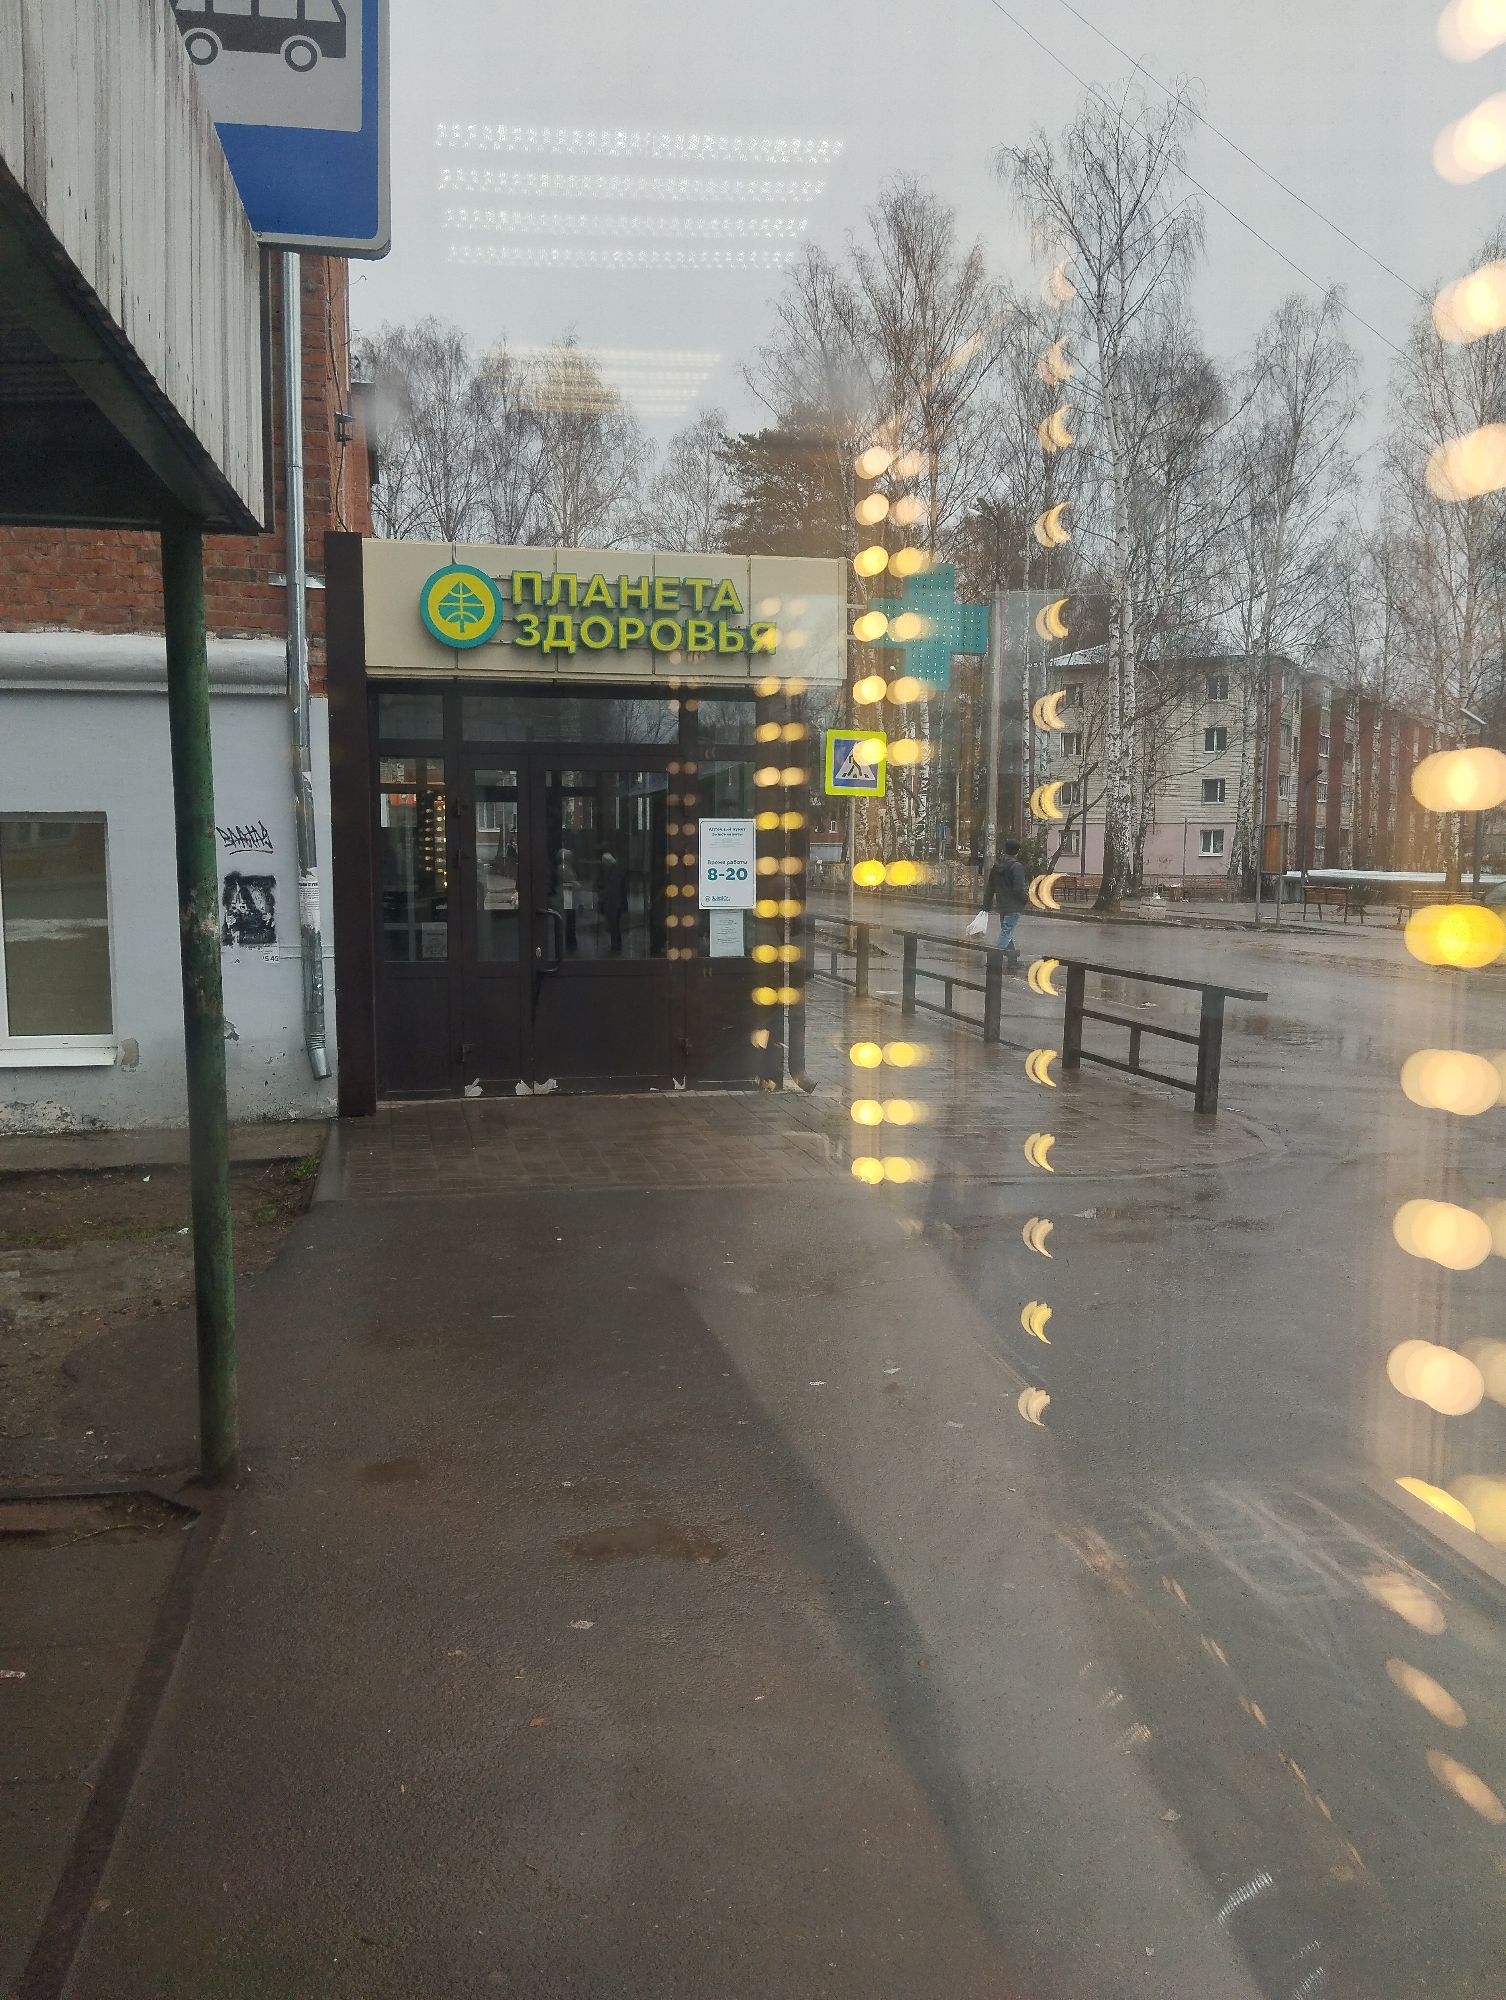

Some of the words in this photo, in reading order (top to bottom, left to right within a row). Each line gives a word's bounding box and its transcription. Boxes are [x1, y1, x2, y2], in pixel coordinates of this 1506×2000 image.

[512, 570, 744, 614] ПЛАНЕТА
[514, 613, 777, 655] ЗДОРОВЬЯ
[707, 867, 748, 881] 8-20
